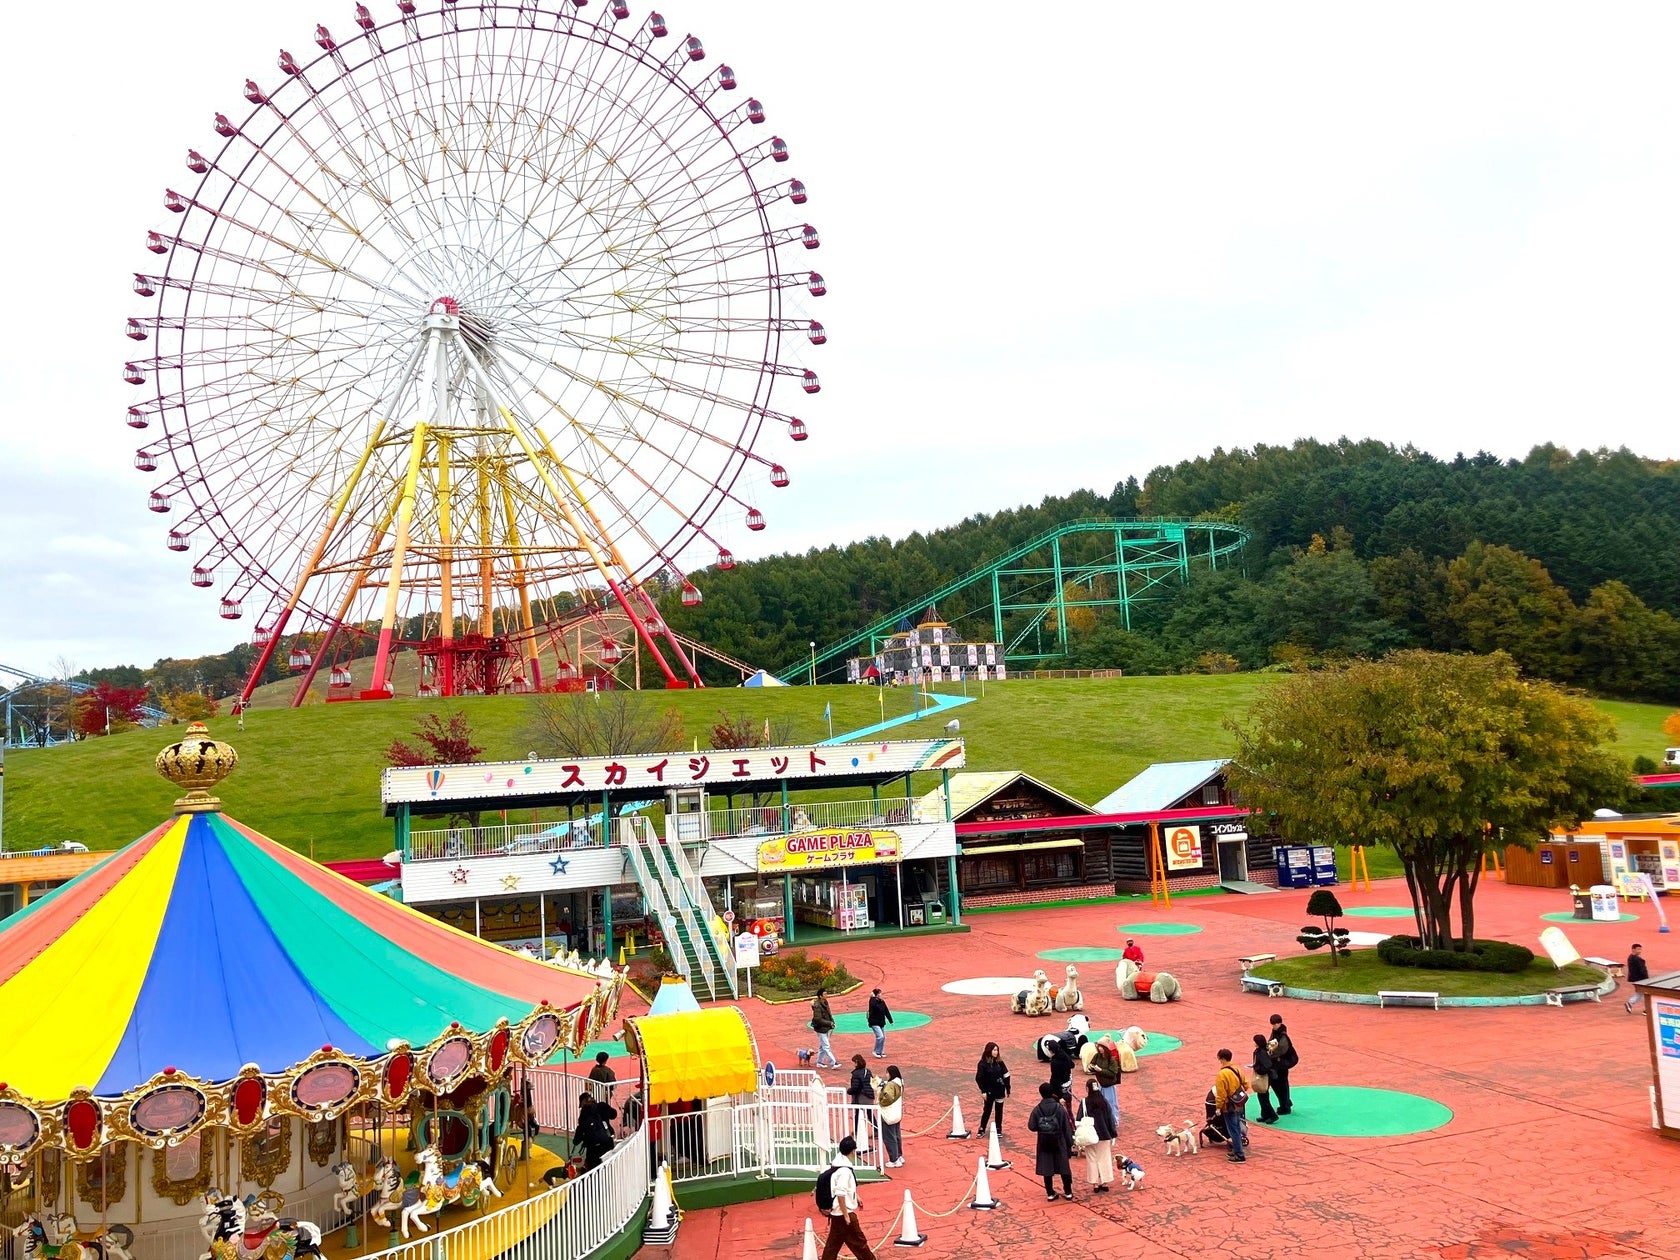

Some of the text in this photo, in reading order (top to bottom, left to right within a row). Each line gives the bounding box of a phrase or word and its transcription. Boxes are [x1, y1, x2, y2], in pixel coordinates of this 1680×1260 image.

[561, 750, 826, 789] スカイジェット
[787, 833, 873, 852] GAME PLAZA
[806, 851, 855, 863] ゲームプラザ
